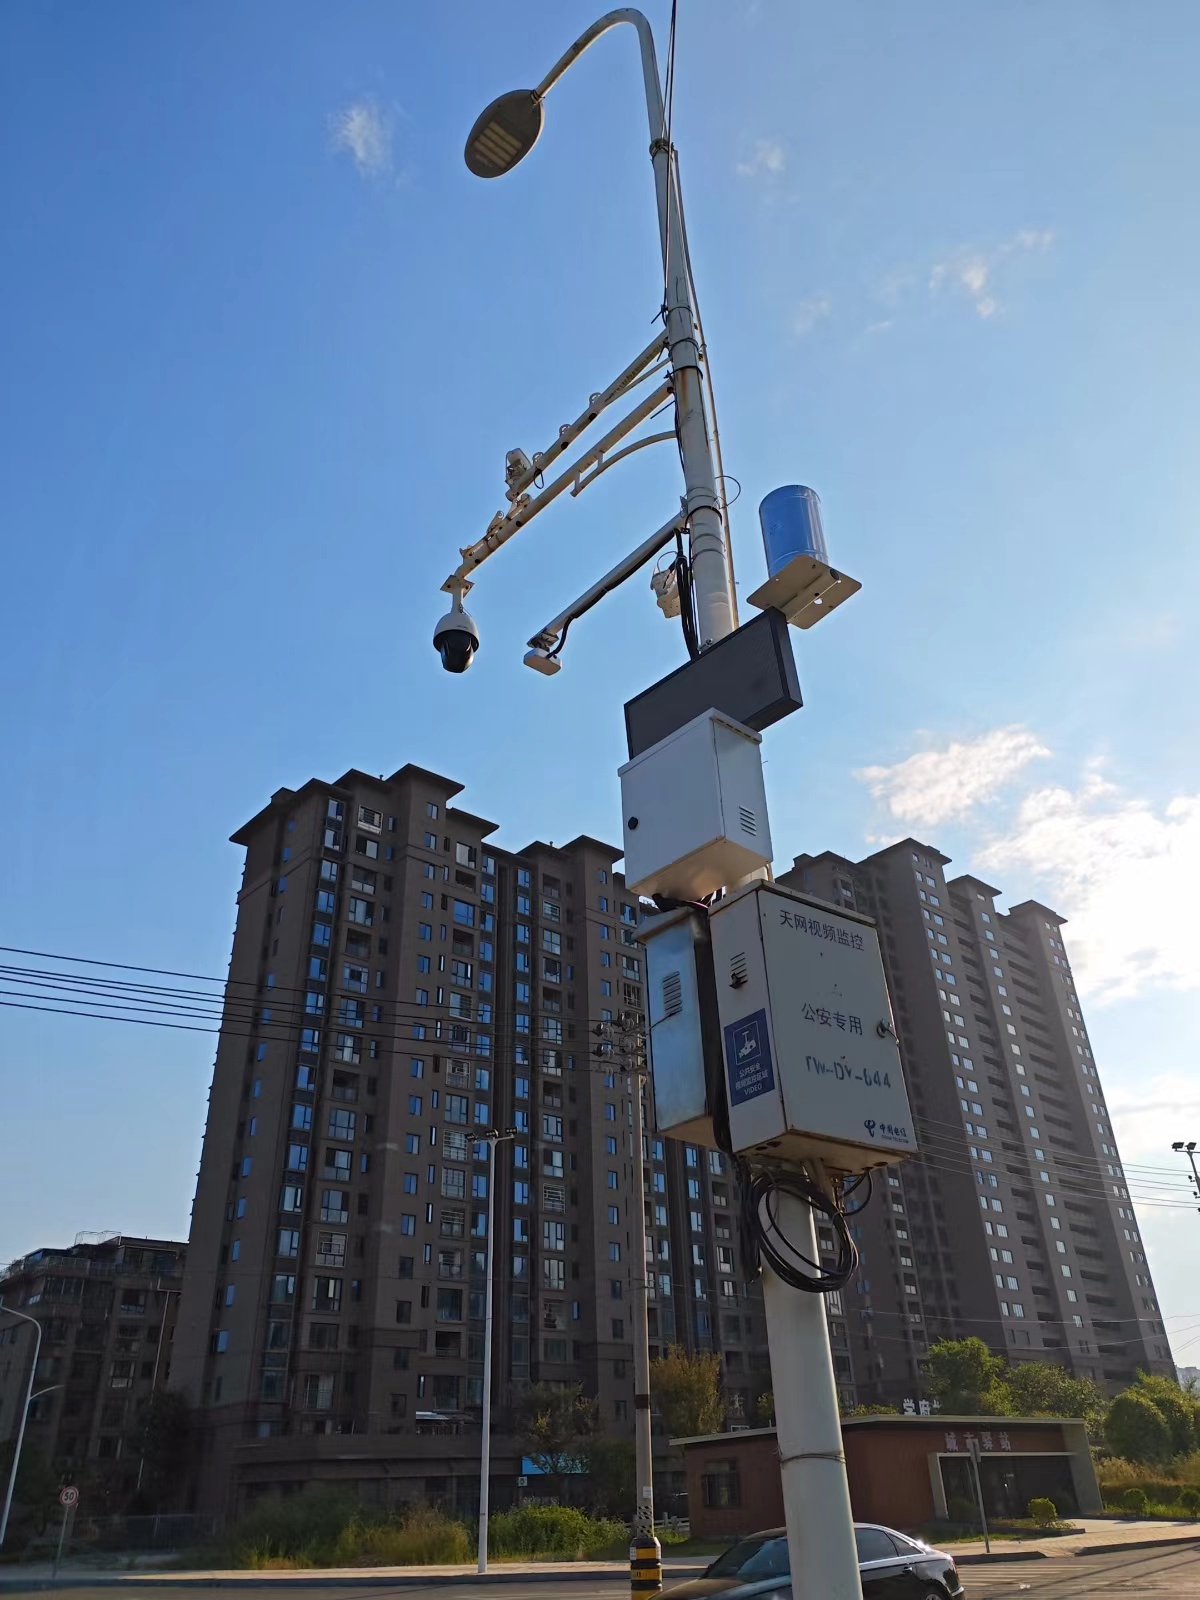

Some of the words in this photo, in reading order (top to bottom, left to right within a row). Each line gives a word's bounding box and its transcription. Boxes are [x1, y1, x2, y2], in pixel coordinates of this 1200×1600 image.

[779, 909, 865, 952] 天网视频监控
[801, 1002, 863, 1036] 公安专用
[739, 1061, 761, 1078] 公共安全
[743, 1082, 763, 1096] VIDEO
[64, 1491, 75, 1501] 50
